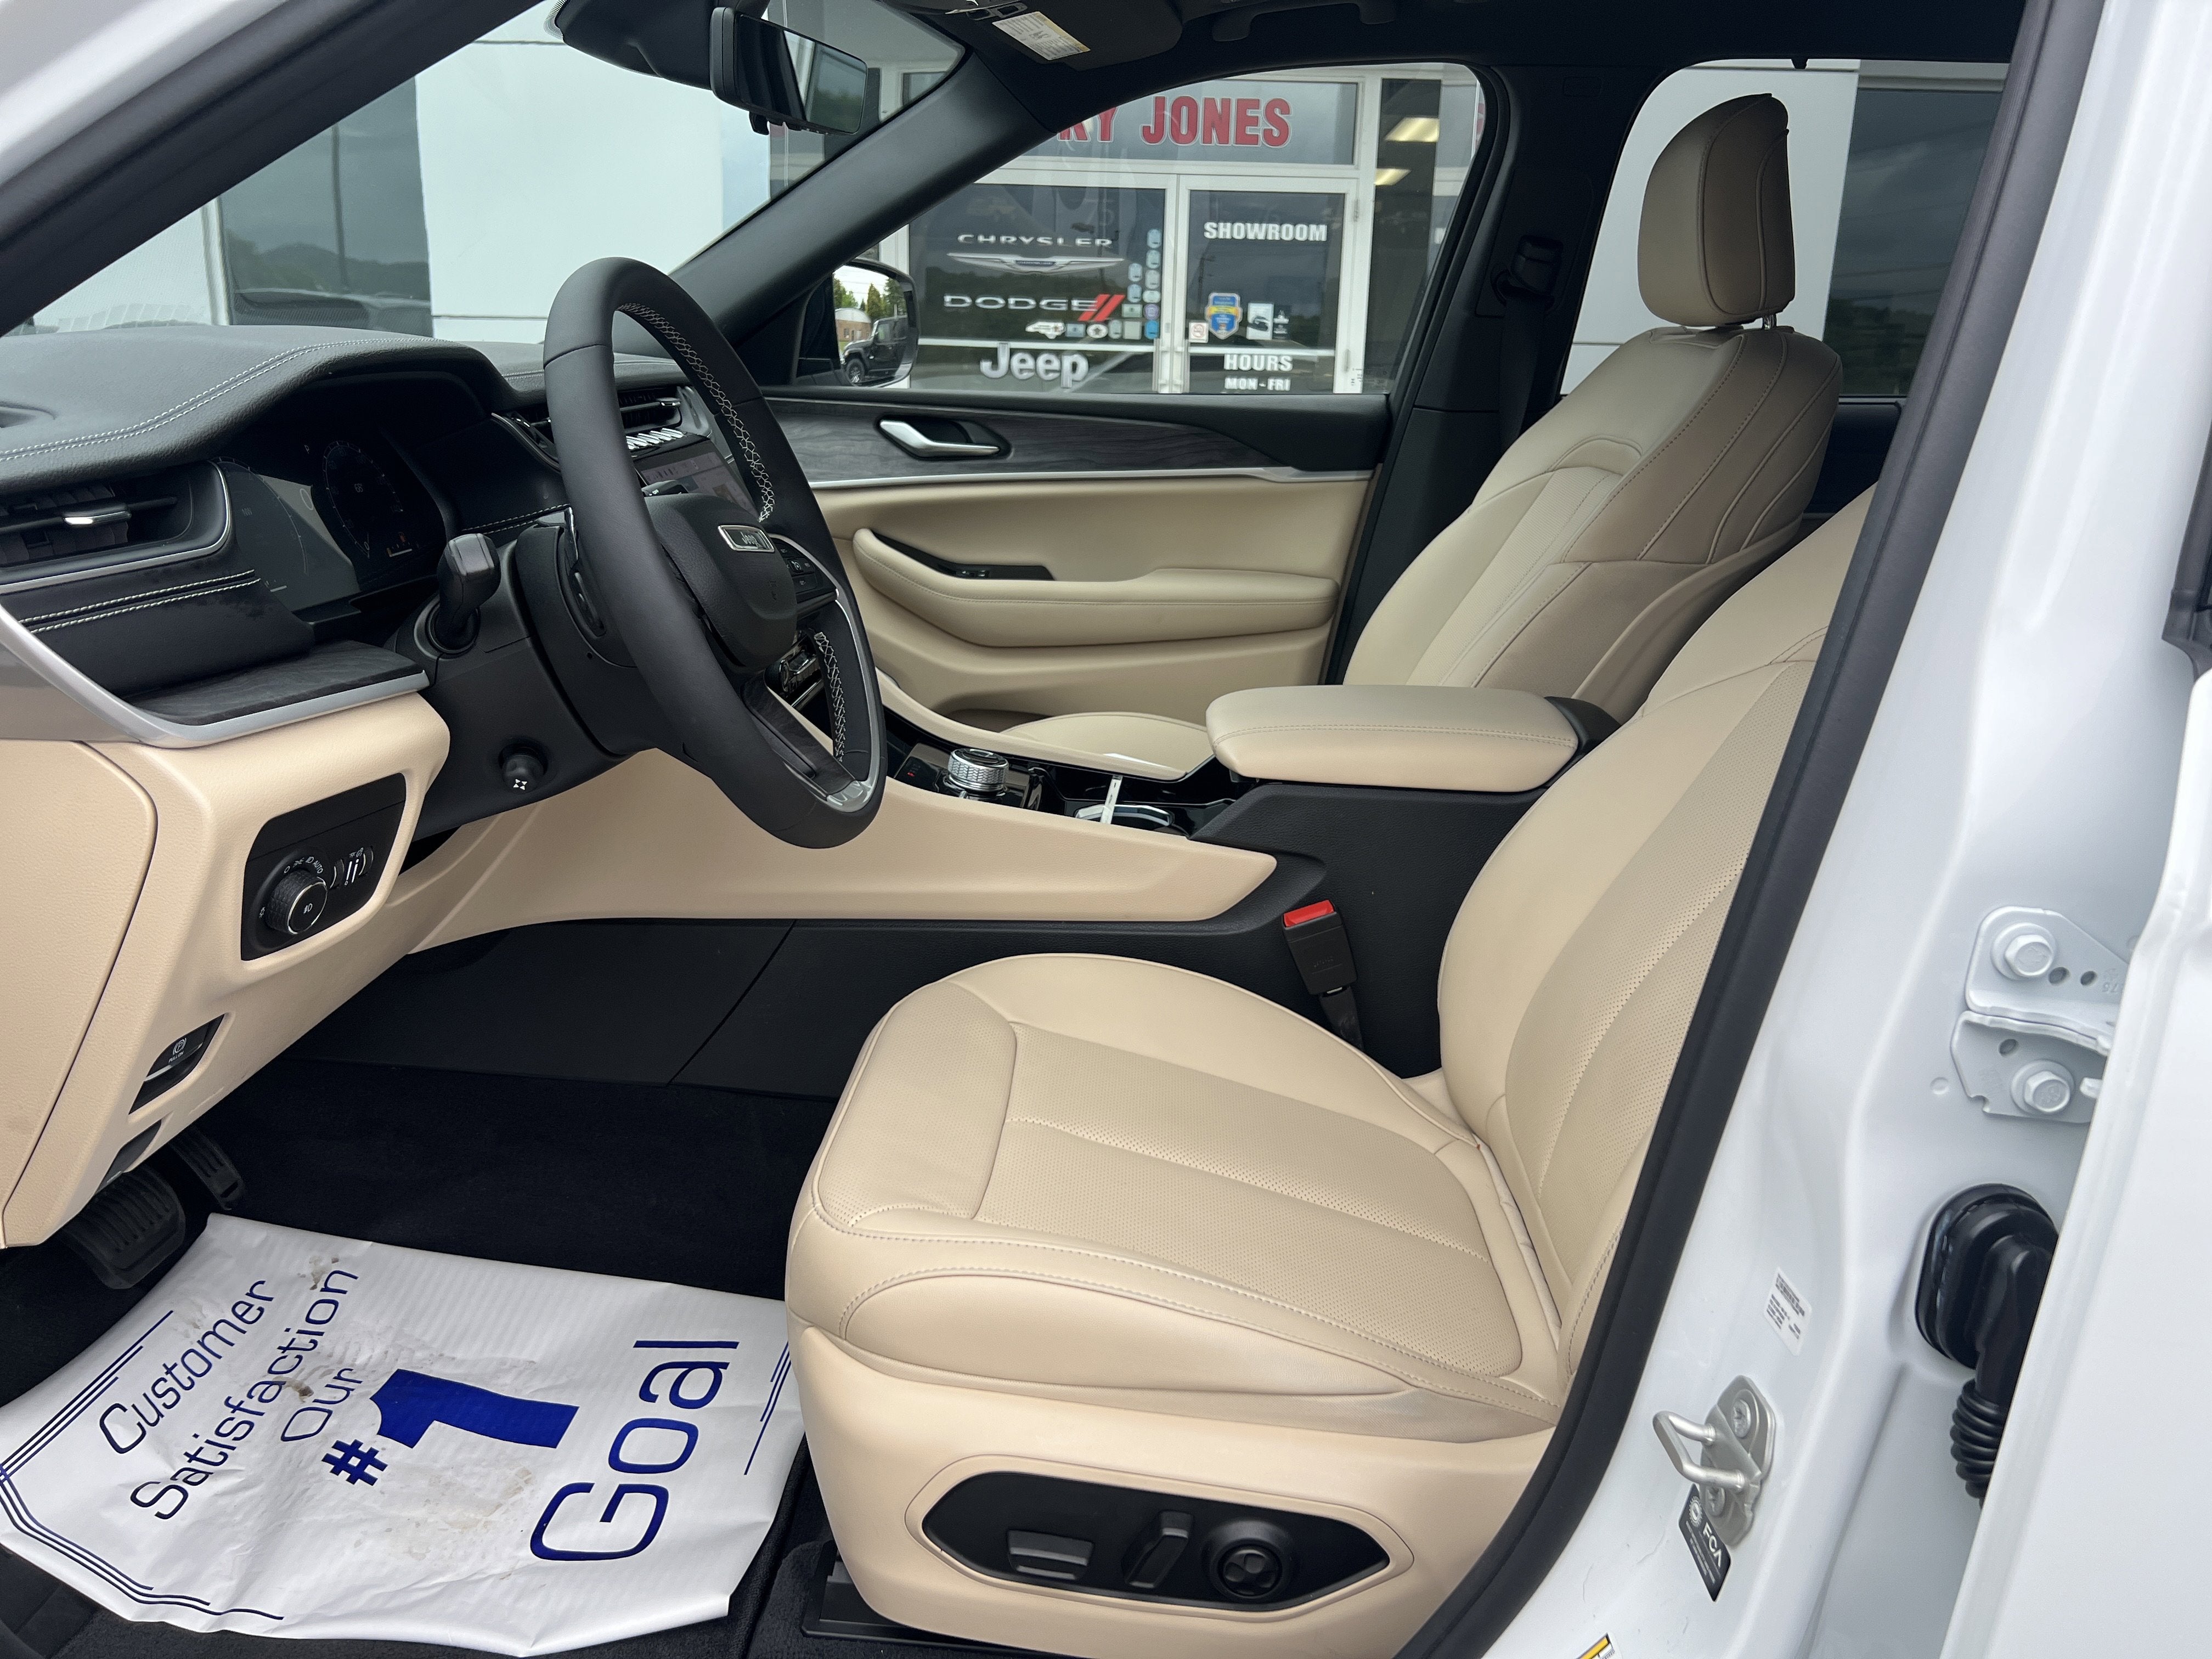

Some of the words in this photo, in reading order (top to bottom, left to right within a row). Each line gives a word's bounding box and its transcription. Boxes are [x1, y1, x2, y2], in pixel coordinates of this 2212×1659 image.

[1141, 95, 1292, 147] JONES
[957, 234, 1113, 247] CHRYSLER
[1204, 222, 1328, 241] SHOWROOM
[944, 294, 1098, 311] DODGE
[980, 342, 1089, 388] Jeep
[1224, 354, 1293, 371] HOURS
[741, 531, 760, 547] Jeep
[313, 860, 324, 874] AUTO
[99, 1280, 274, 1454] Customer
[130, 1269, 359, 1520] Satisfaction
[280, 1368, 363, 1442] Our
[531, 1340, 738, 1561] Goal
